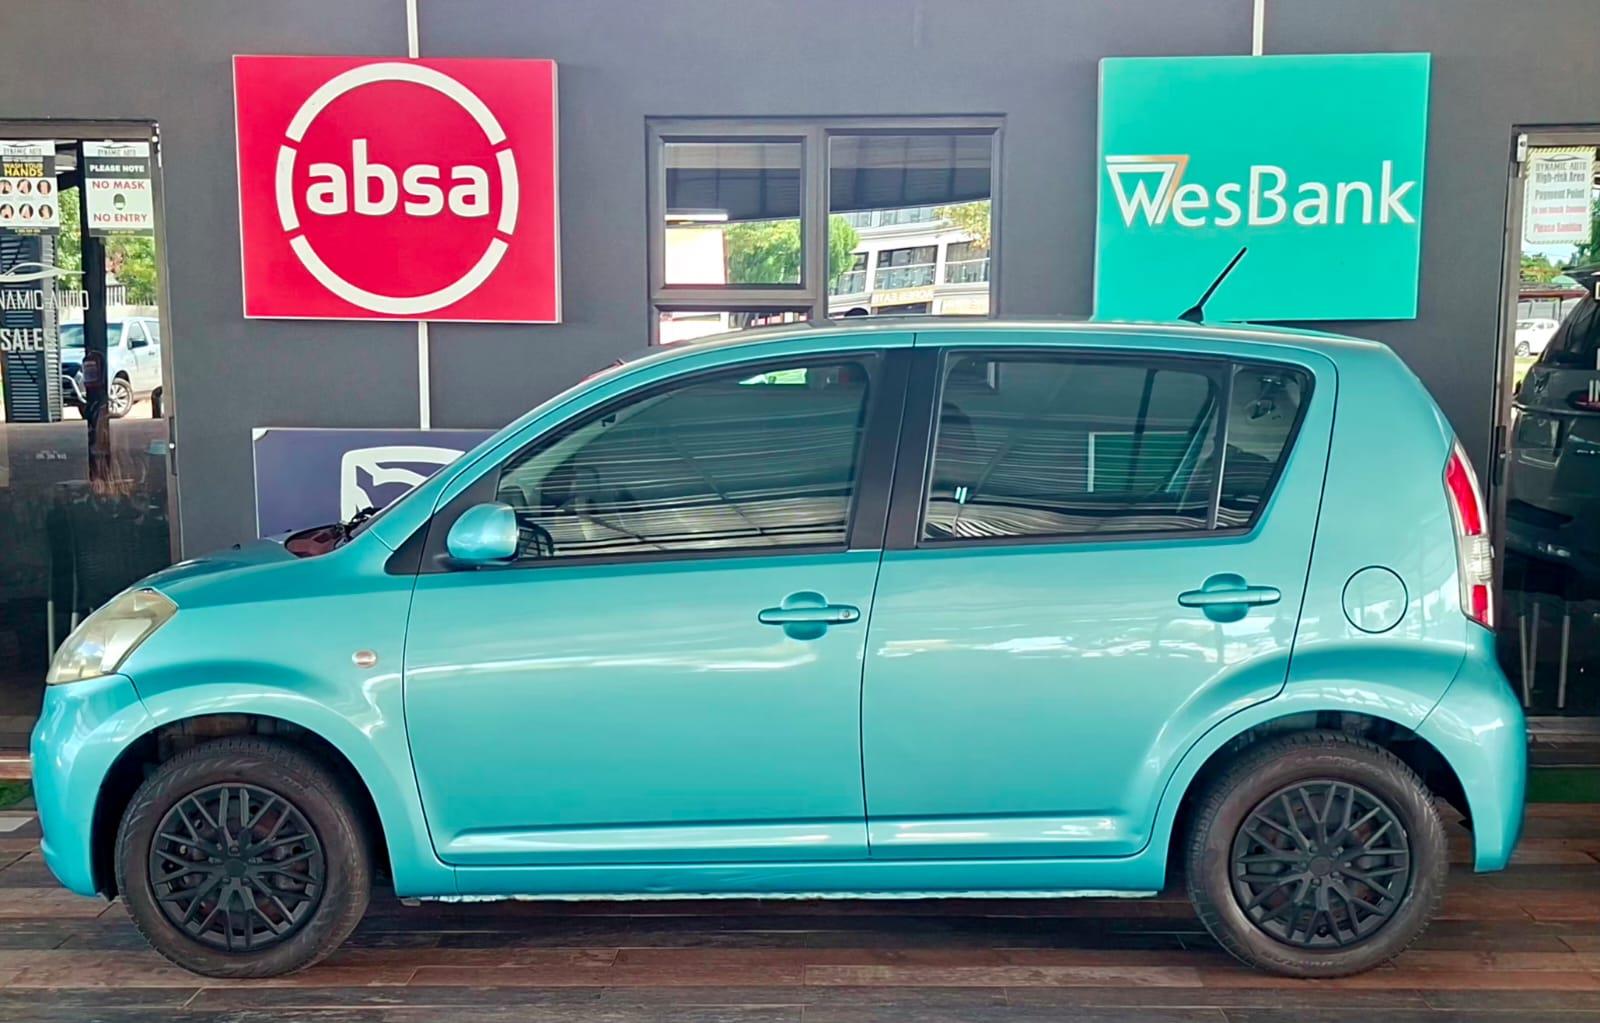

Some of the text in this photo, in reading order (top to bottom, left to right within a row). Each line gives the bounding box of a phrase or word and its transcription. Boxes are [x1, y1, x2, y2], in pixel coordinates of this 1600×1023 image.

[4, 168, 44, 177] HANDS
[89, 164, 145, 172] PLEASE NOTE
[306, 138, 490, 217] absa
[92, 181, 145, 189] NO MASK
[1105, 154, 1416, 227] WesBank
[93, 213, 148, 222] NO ENTRY
